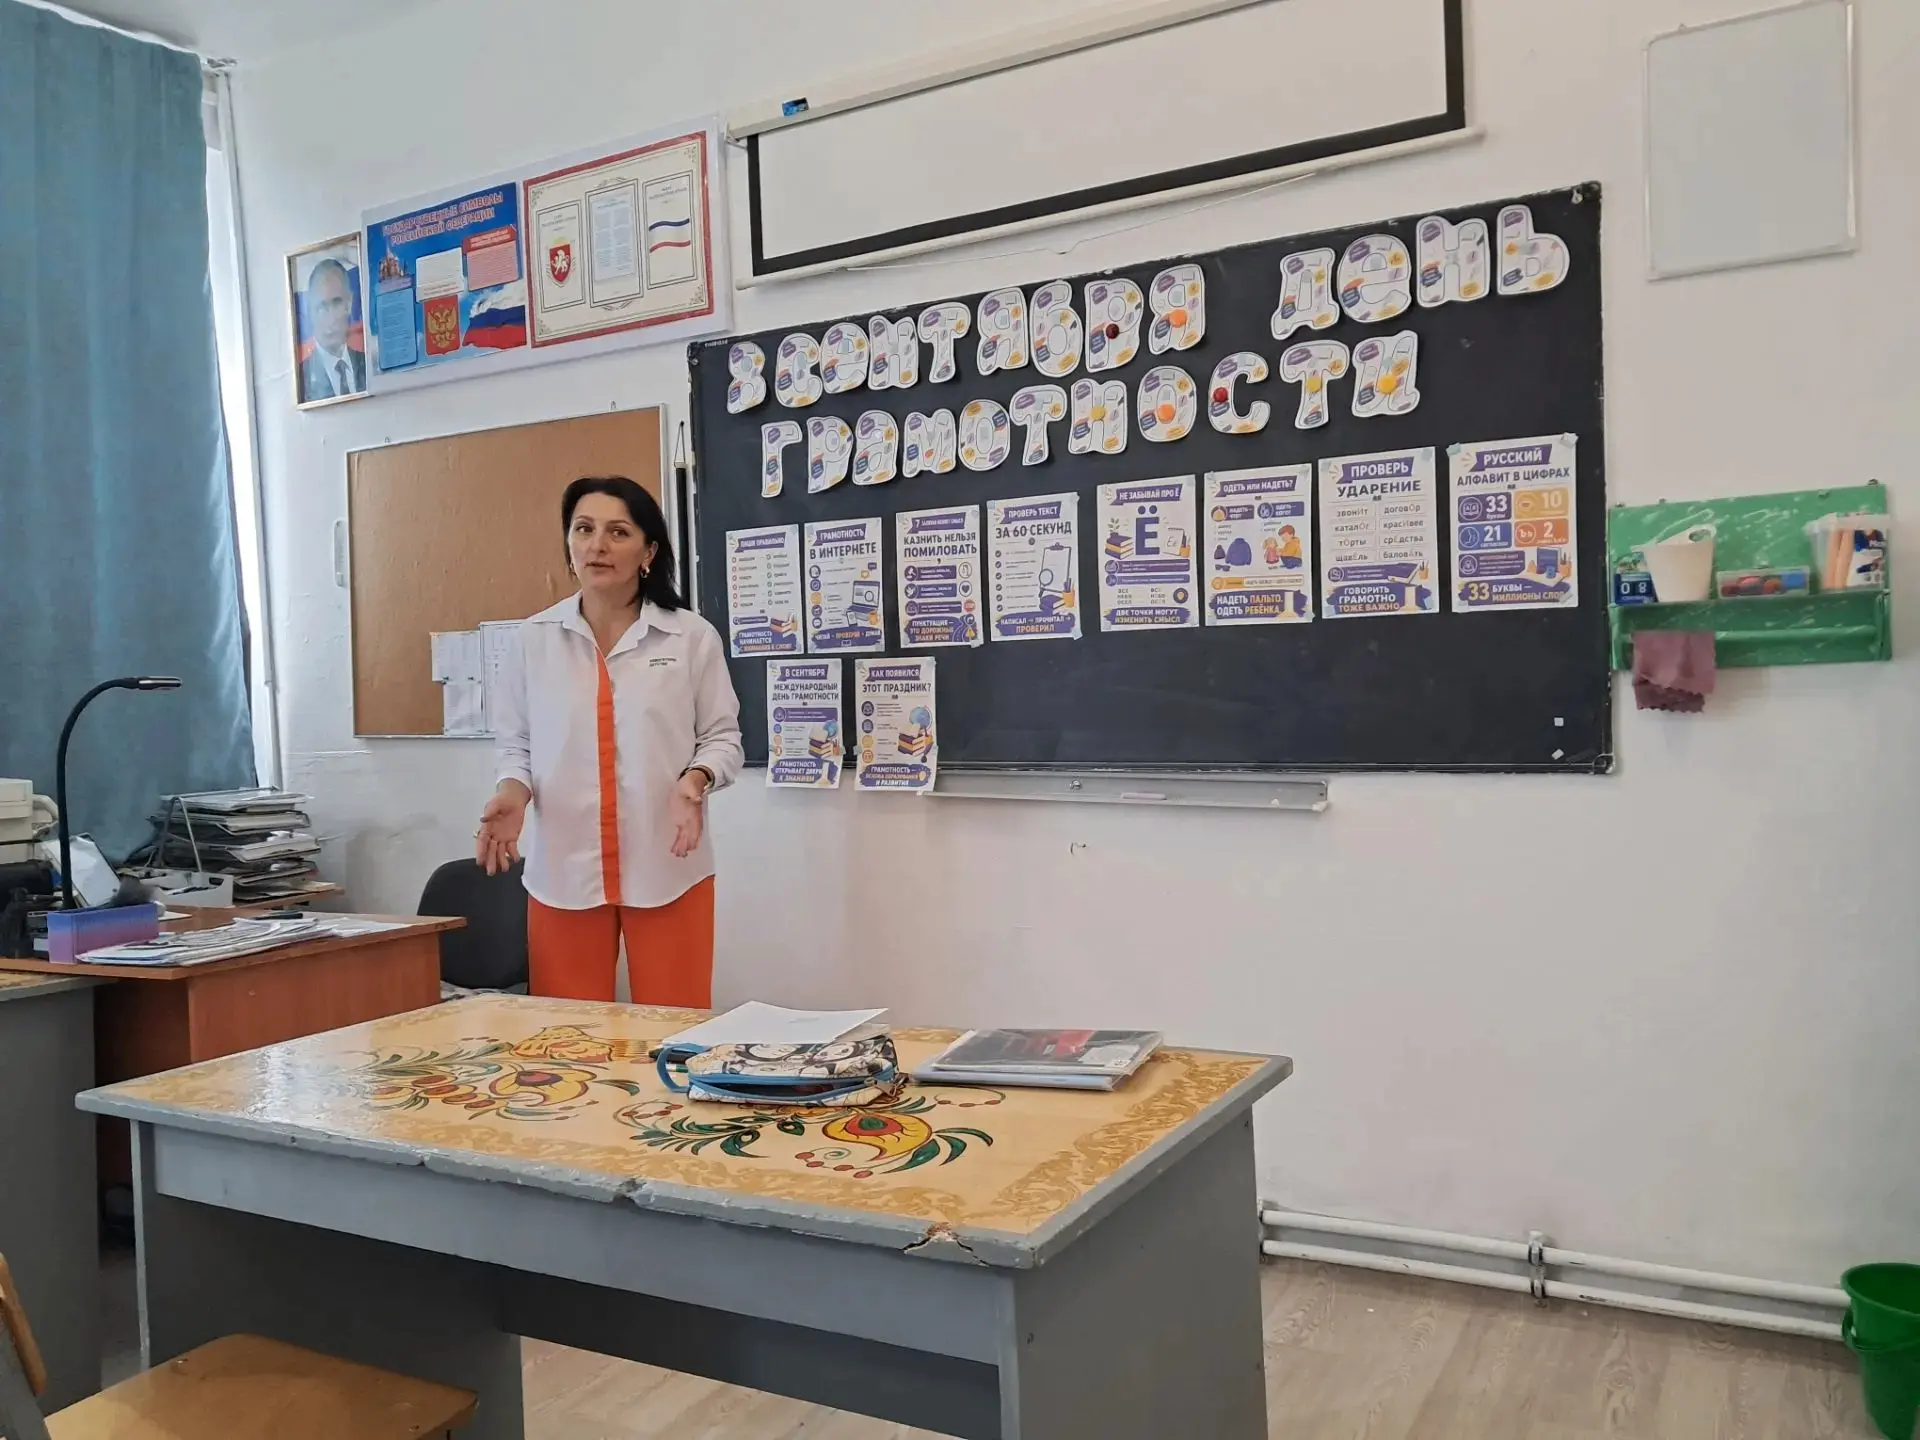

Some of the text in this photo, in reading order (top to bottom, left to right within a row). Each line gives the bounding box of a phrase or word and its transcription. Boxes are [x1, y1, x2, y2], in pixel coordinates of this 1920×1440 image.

[446, 207, 495, 230] ФЕДЕРАЦИИ
[727, 342, 766, 414] 8
[1484, 448, 1542, 465] РУССКИЙ
[1351, 462, 1409, 478] ПРОВЕРЬ
[1457, 467, 1570, 486] АЛФАВИТ В ЦИФРАХ
[1224, 484, 1246, 493] ОДЕТЬ
[1262, 480, 1293, 490] НАДЕТЬ?
[1338, 480, 1422, 498] УДАРЕНИЕ
[1120, 492, 1128, 500] НЕ
[1129, 488, 1160, 499] ЗАБЫВАЙ
[1161, 490, 1174, 498] ПРО
[1542, 490, 1562, 509] 10
[1486, 494, 1508, 513] 33
[1008, 506, 1058, 518] ПРОВЕРЬ ТЕКСТ
[915, 520, 920, 528] 7
[996, 522, 1072, 538] ЗА 60 СЕКУНД
[1136, 505, 1160, 555] Ё
[1544, 522, 1554, 538] 2
[820, 528, 864, 540] ГРАМОТНОСТЬ
[904, 532, 976, 545] КАЗНИТЬ НЕЛЬЗЯ
[1484, 526, 1501, 542] 21
[810, 542, 877, 560] В ИНТЕРНЕТЕ
[904, 544, 978, 558] ПОМИЛОВАТЬ
[1344, 586, 1390, 594] ГОВОРИТЬ
[1468, 582, 1522, 600] 33 БУКВЫ
[1216, 594, 1283, 605] НАДЕТЬ ПАЛЬТО.
[1339, 594, 1396, 604] ГРАМОТНО
[1492, 592, 1542, 602] МИЛЛИОНЫ
[1216, 606, 1243, 616] ОДЕТЬ
[1340, 602, 1400, 612] ТОЖЕ ВАЖНО
[1016, 624, 1054, 633] ПРОВЕРИЛ
[786, 668, 825, 677] 8 СЕНТЯБРЯ
[886, 669, 920, 678] ПОЯВИЛСЯ
[774, 682, 838, 691] МЕЖДУНАРОДНЫЙ
[862, 682, 932, 693] ЭТОТ ПРАЗДНИК?
[772, 693, 790, 701] ДЕНЬ
